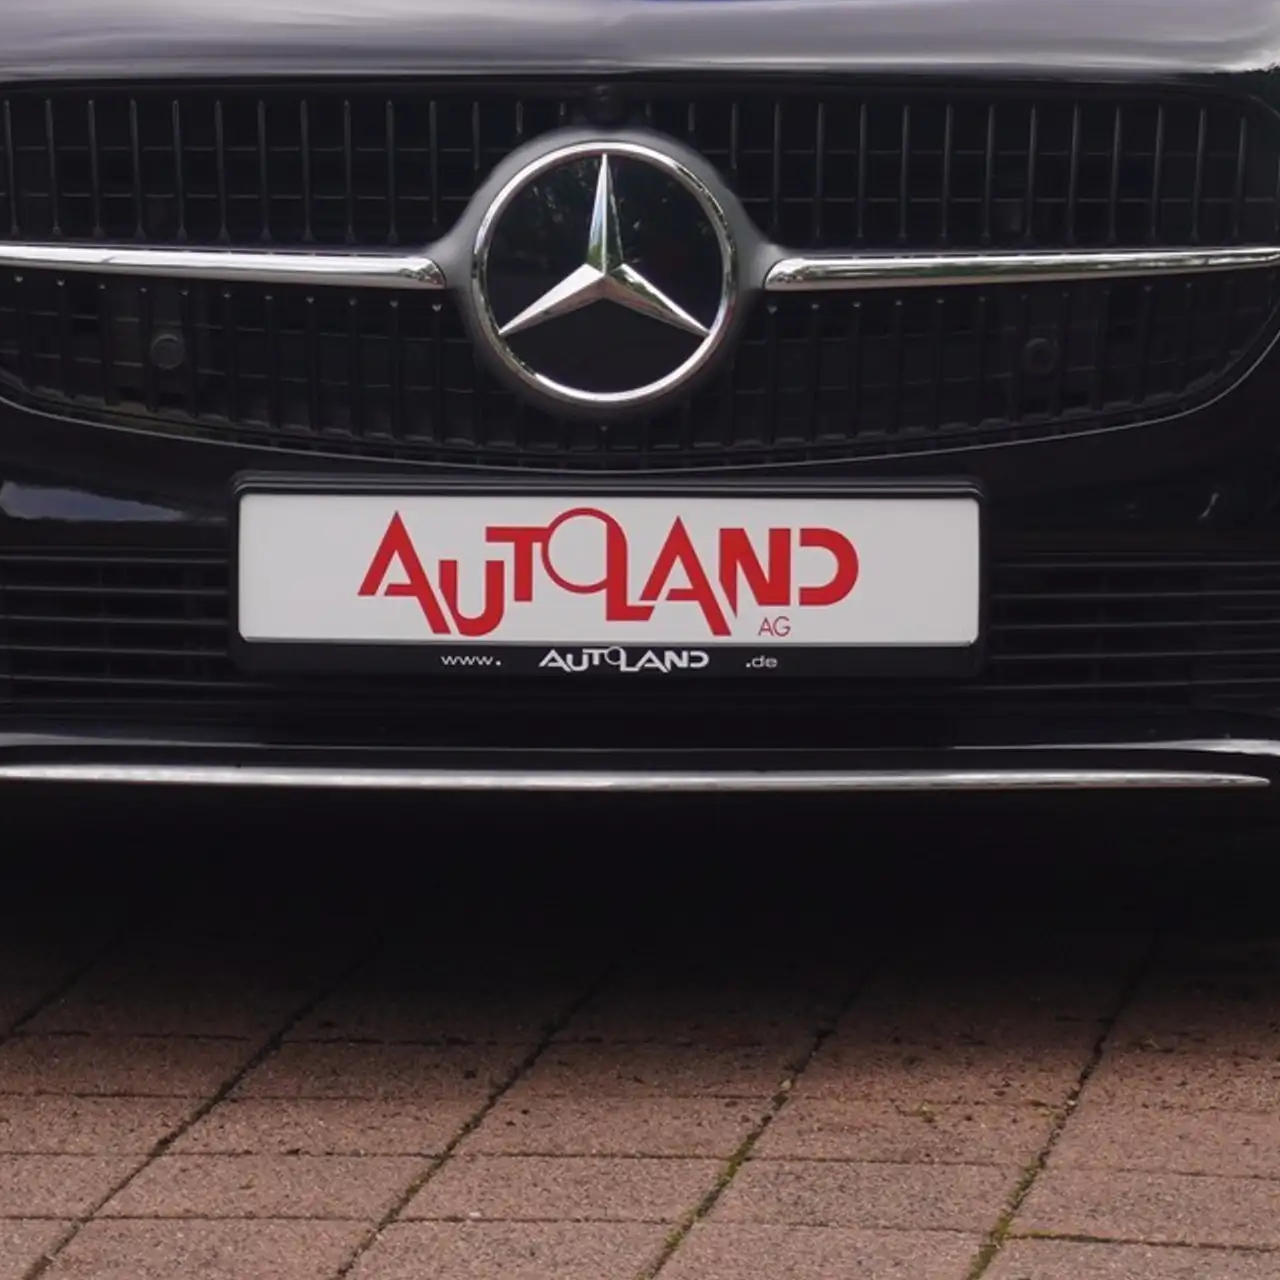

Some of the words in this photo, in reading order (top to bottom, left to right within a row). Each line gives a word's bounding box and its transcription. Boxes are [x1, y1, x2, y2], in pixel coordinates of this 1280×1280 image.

[357, 507, 860, 637] AUTOLAND
[757, 615, 792, 637] AG
[440, 654, 502, 667] www.
[537, 645, 711, 673] AUTOLAND
[744, 653, 779, 669] .de
